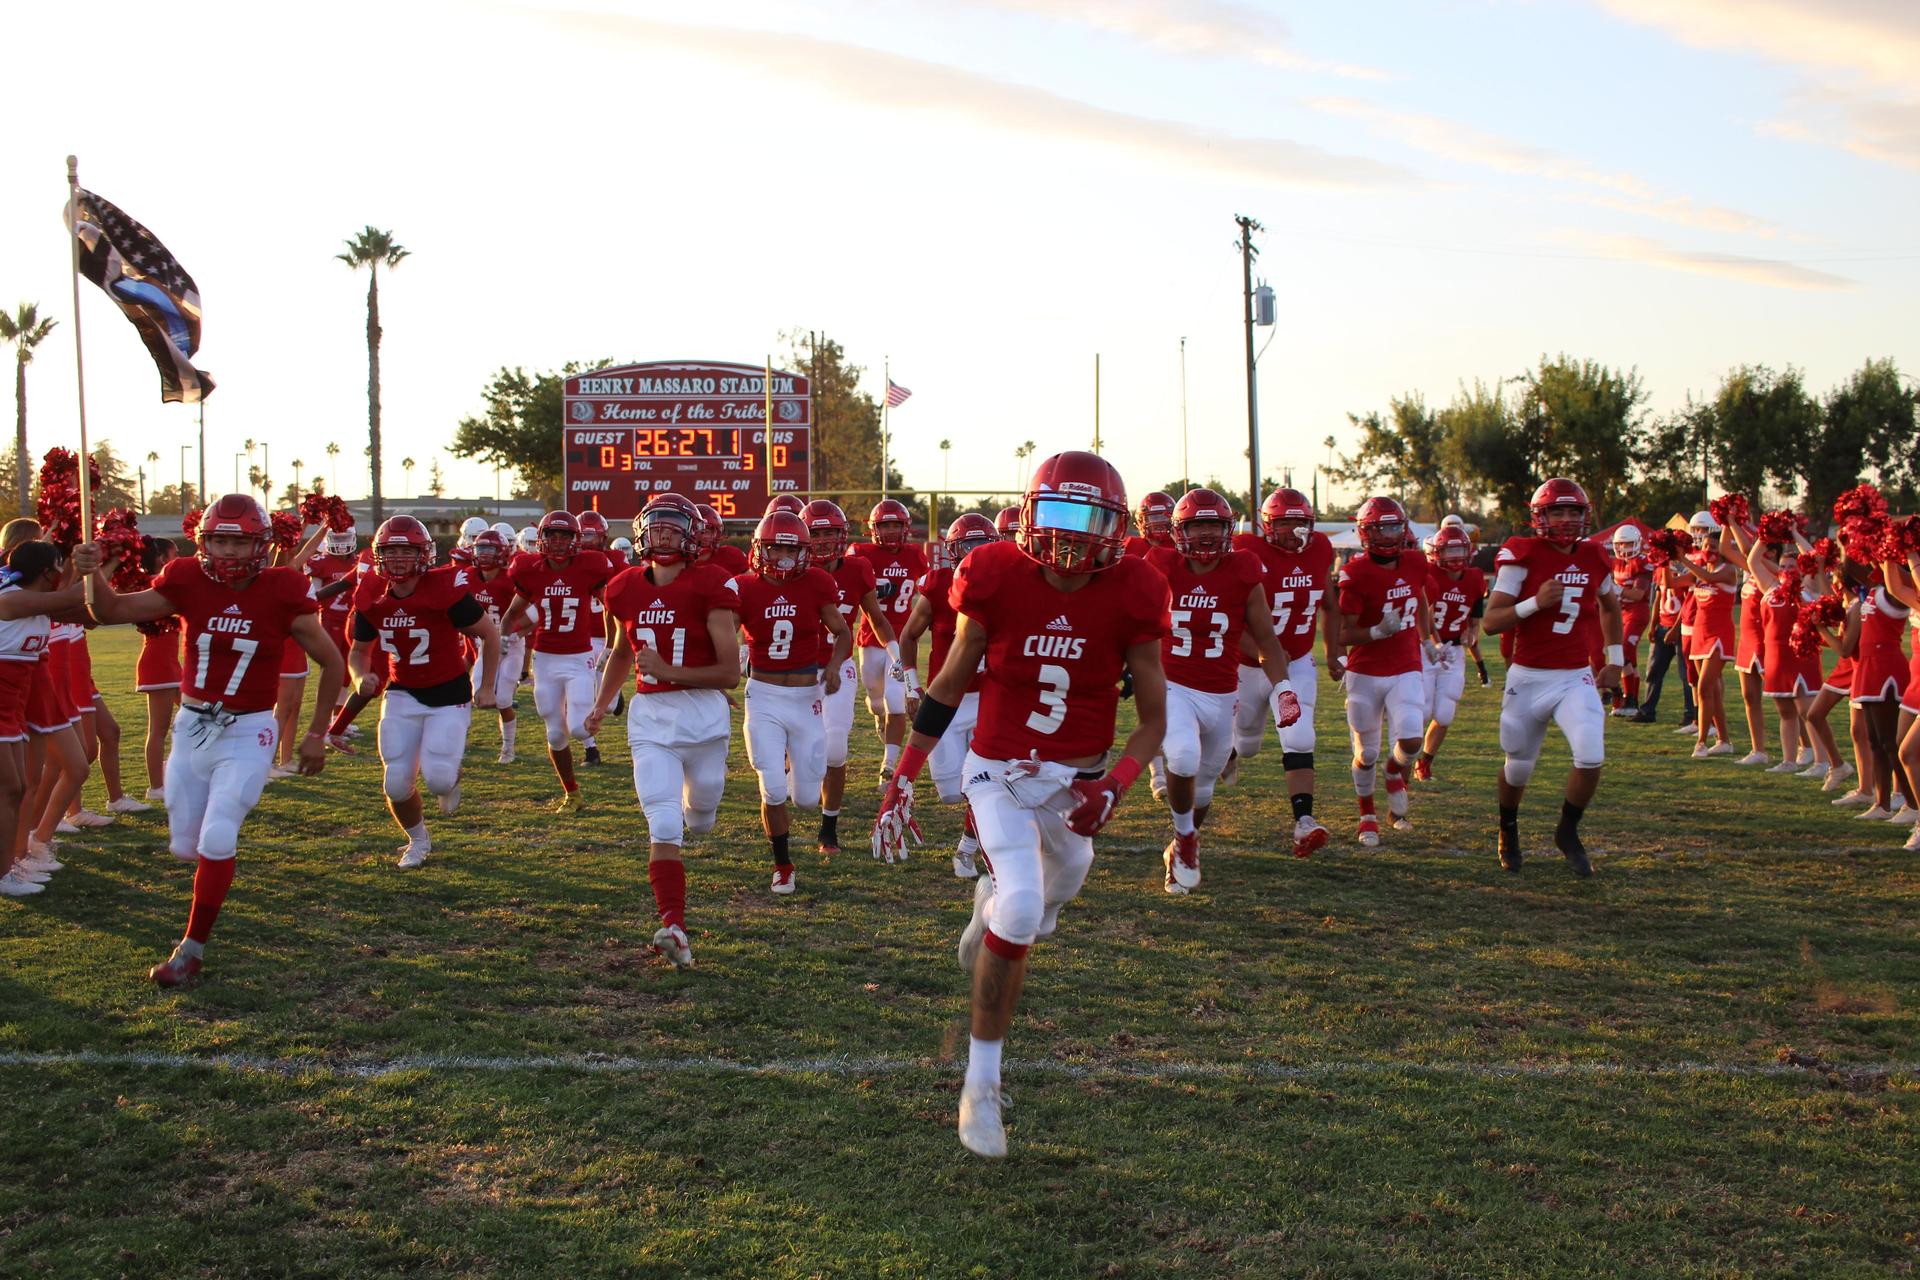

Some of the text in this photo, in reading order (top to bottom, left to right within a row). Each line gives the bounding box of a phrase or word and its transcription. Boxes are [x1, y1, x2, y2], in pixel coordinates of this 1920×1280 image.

[579, 378, 794, 394] HENRY MASSARO STADIUM
[600, 403, 657, 420] Home
[661, 403, 682, 424] of
[687, 403, 715, 419] the
[574, 432, 625, 445] GUEST
[601, 446, 615, 468] 0
[621, 454, 632, 471] 3
[743, 453, 754, 470] 3
[773, 445, 787, 467] 0
[634, 461, 653, 470] TOL
[723, 461, 741, 470] TOL
[572, 480, 611, 491] DOWN
[634, 480, 672, 490] TO GO
[694, 479, 750, 490] BALL ON
[592, 494, 599, 512] 1
[708, 494, 736, 515] 35
[883, 567, 909, 578] CUHS
[1555, 573, 1590, 585] CUHS
[1282, 575, 1313, 588] CUHS
[475, 593, 494, 604] CUHS
[544, 586, 572, 597] CUHS
[1387, 585, 1412, 600] CUHS
[1442, 592, 1467, 603] CUHS
[1179, 594, 1219, 609] CUHS
[540, 598, 580, 633] 15
[638, 610, 676, 625] CUHS
[764, 604, 797, 619] CUHS
[1552, 586, 1585, 635] 5
[207, 616, 253, 635] CUHS
[383, 616, 417, 628] CUHS
[768, 619, 794, 660] 8
[1170, 610, 1230, 659] 53
[378, 628, 430, 665] 52
[1023, 635, 1087, 660] CUHS
[194, 632, 260, 696] 17
[1025, 664, 1071, 735] 3
